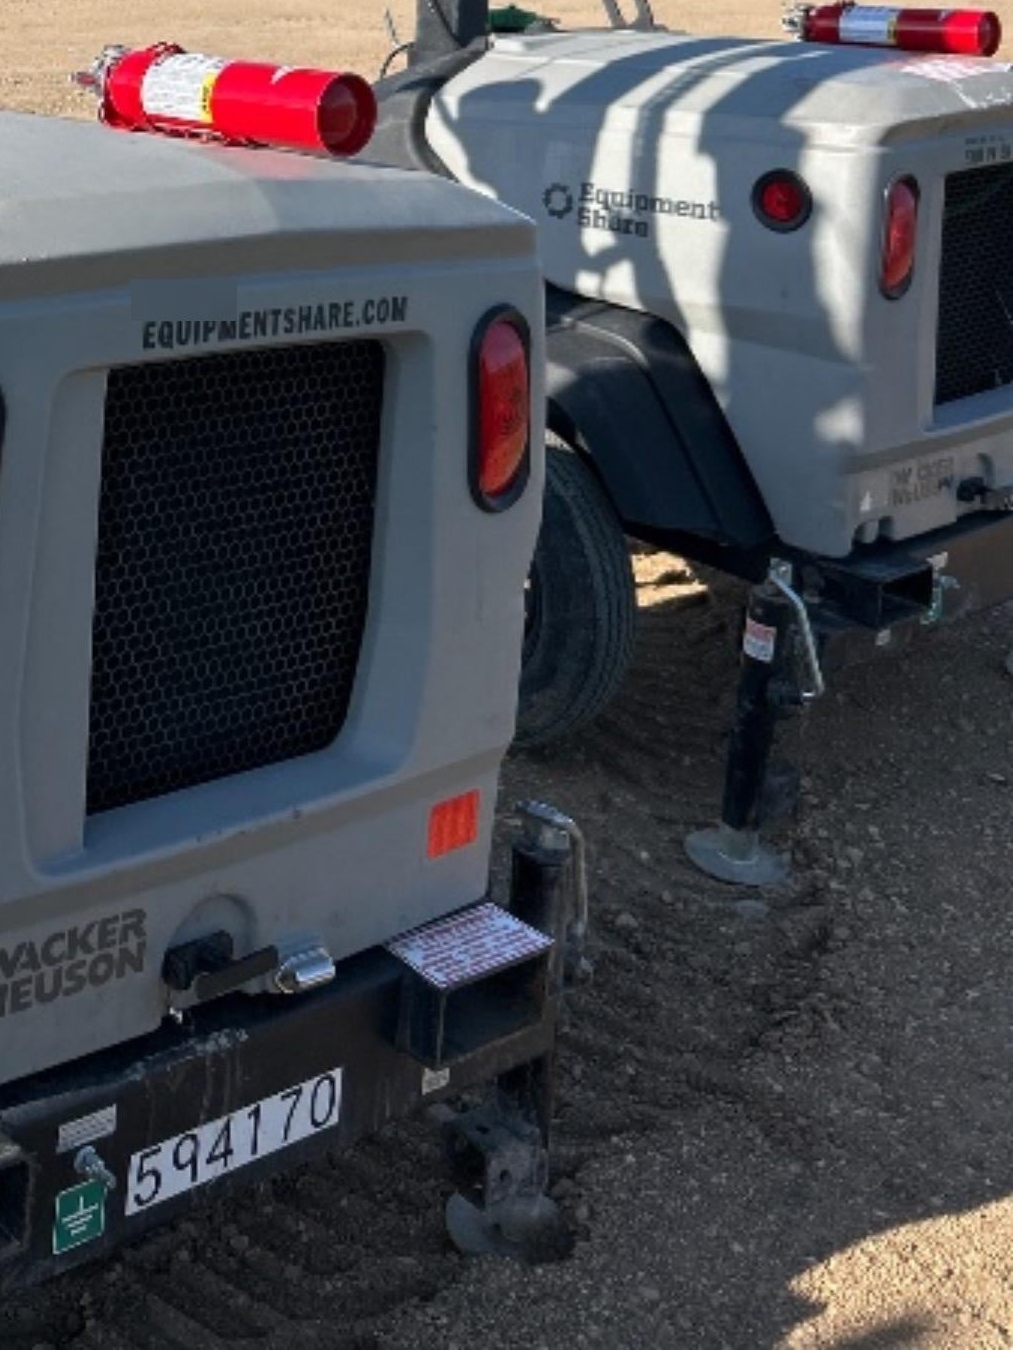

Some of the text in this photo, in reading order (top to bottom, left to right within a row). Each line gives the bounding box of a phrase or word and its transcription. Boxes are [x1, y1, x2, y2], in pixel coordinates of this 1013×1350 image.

[577, 182, 725, 221] Equipment
[142, 296, 409, 349] EQUIPMENTSHARE.COM
[133, 1073, 336, 1206] 594170
